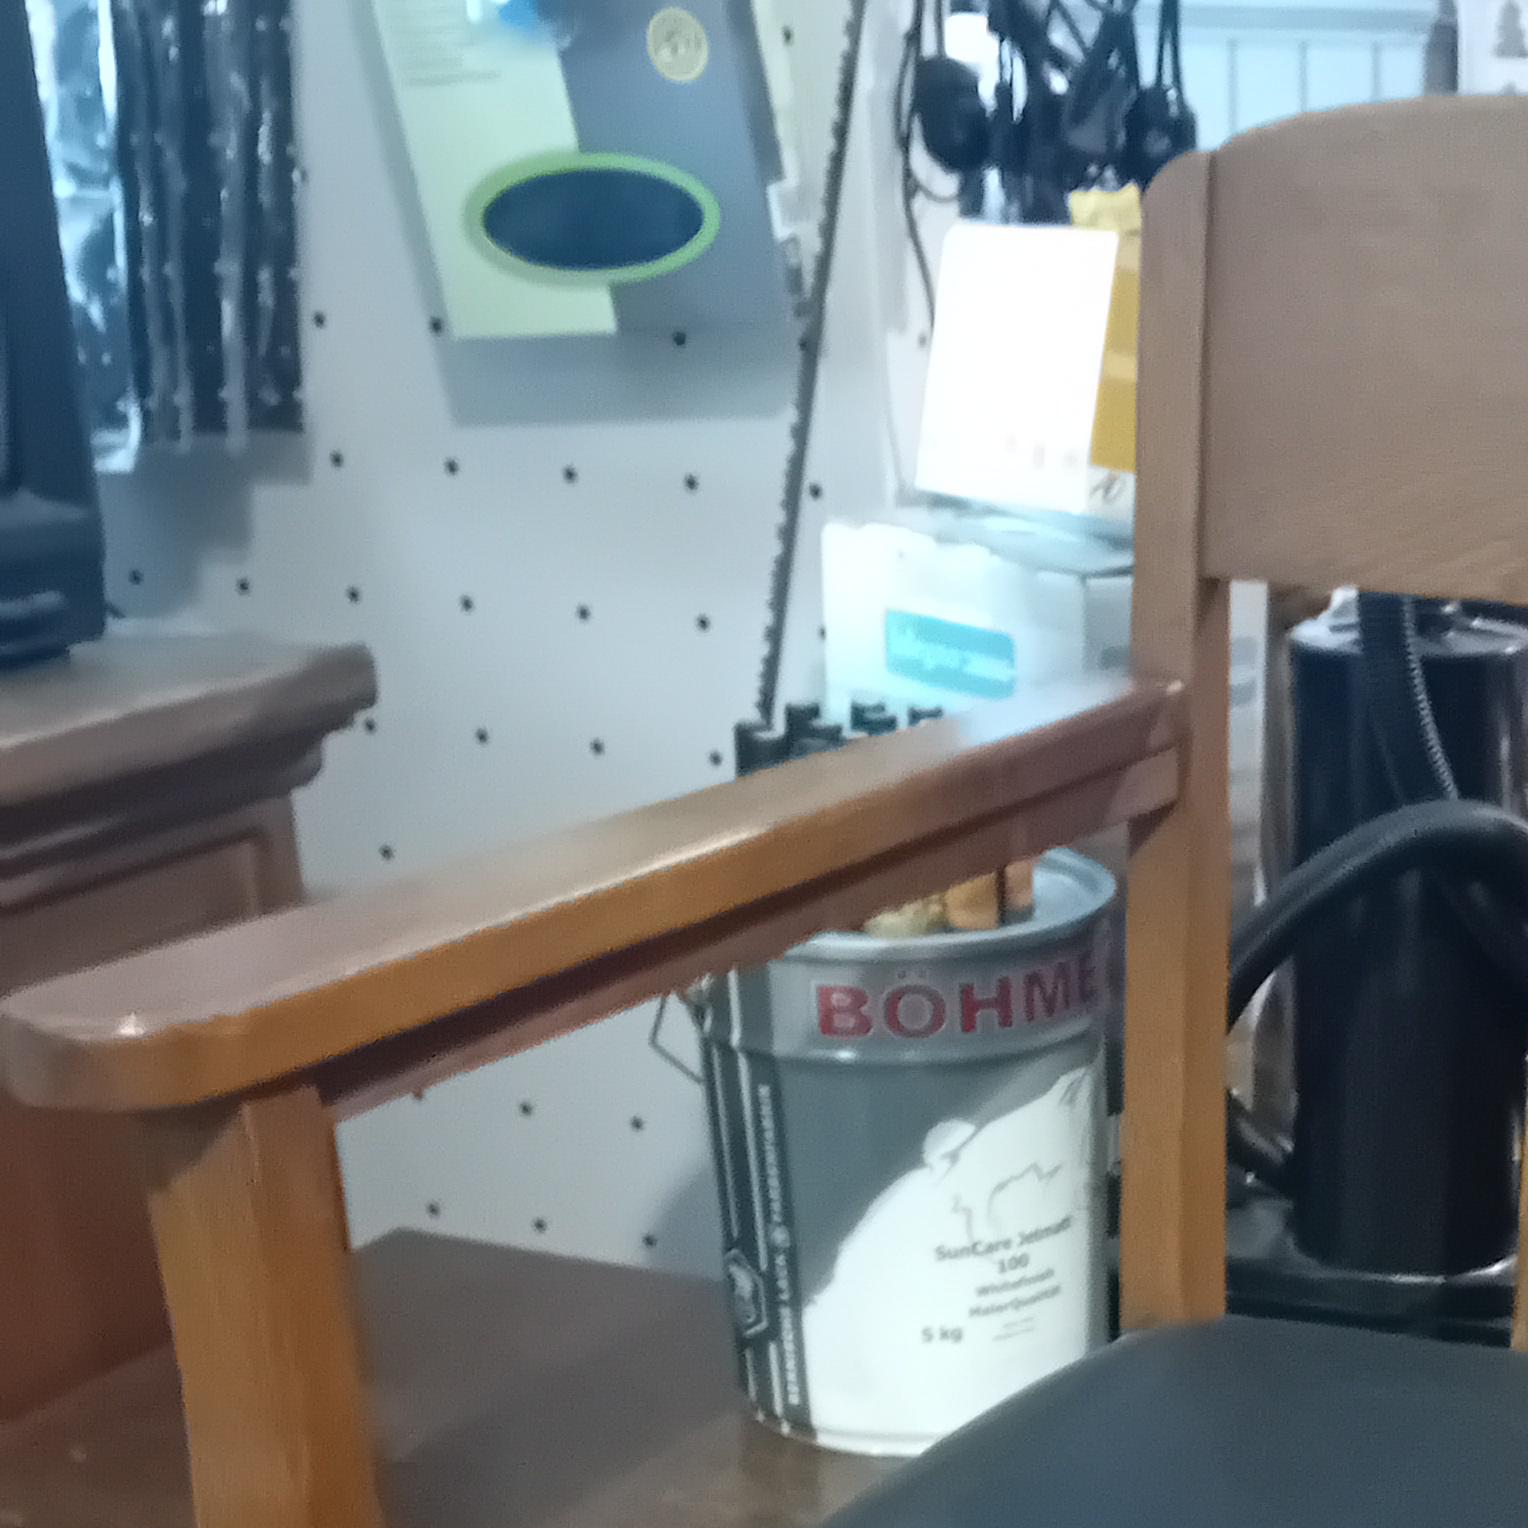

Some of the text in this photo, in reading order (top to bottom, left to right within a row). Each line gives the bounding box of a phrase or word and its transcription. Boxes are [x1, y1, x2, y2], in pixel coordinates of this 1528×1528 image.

[934, 1237, 1012, 1261] SunCare
[999, 1252, 1030, 1274] 100
[921, 1325, 963, 1343] 5 kg
